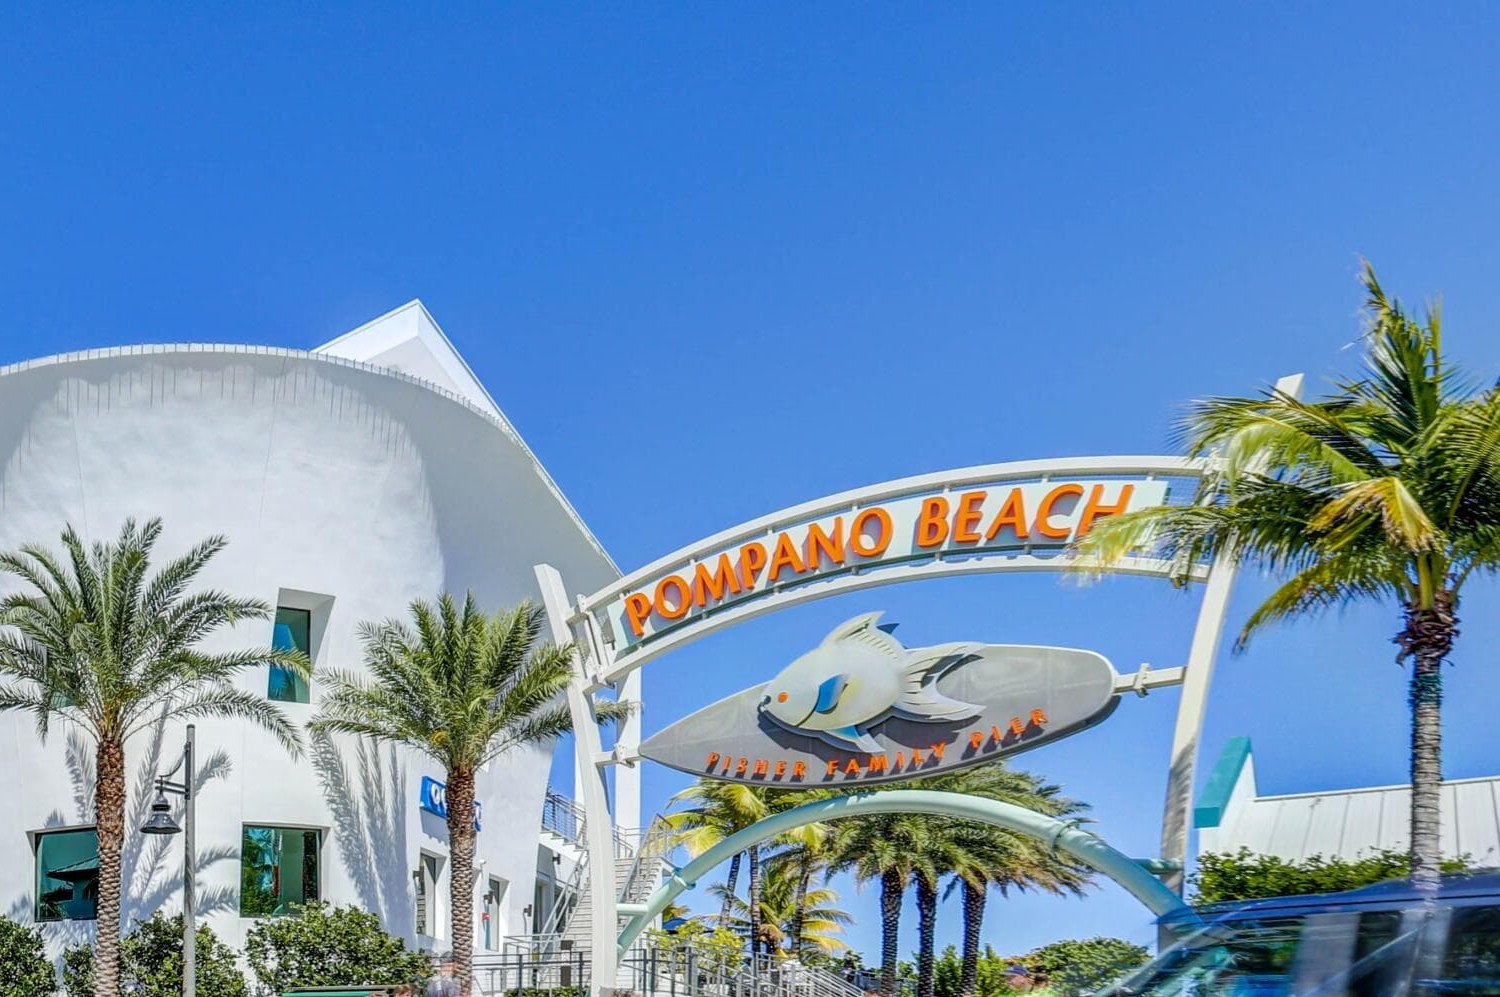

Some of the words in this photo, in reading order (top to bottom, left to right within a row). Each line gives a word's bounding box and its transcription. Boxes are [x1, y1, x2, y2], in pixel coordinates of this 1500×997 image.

[624, 506, 893, 637] POMPANO
[917, 483, 1134, 547] BEACH
[826, 741, 946, 775] FAMILY
[970, 708, 1049, 750] PIER
